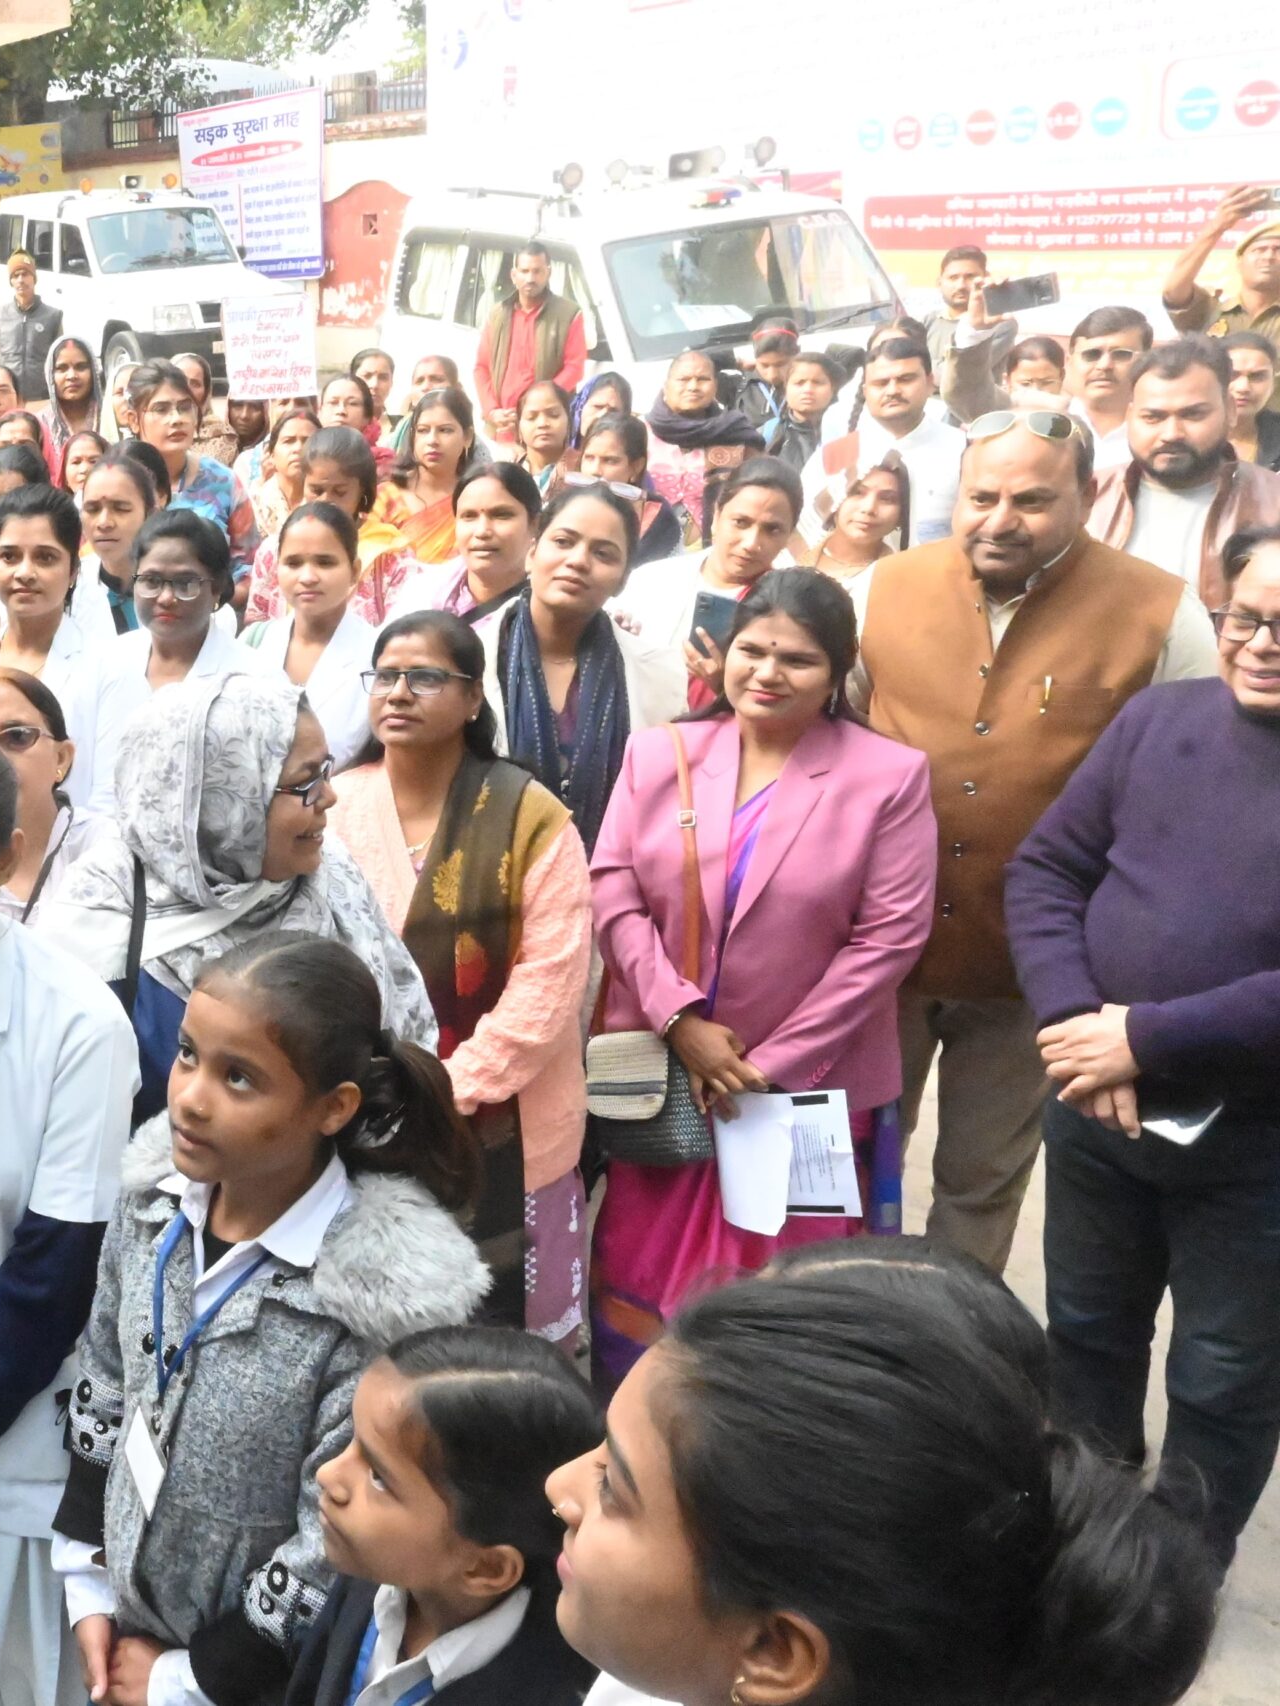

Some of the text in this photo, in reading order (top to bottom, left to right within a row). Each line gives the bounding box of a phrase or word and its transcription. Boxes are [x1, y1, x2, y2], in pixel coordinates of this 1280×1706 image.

[194, 111, 301, 146] सड़क सुरक्षा माह
